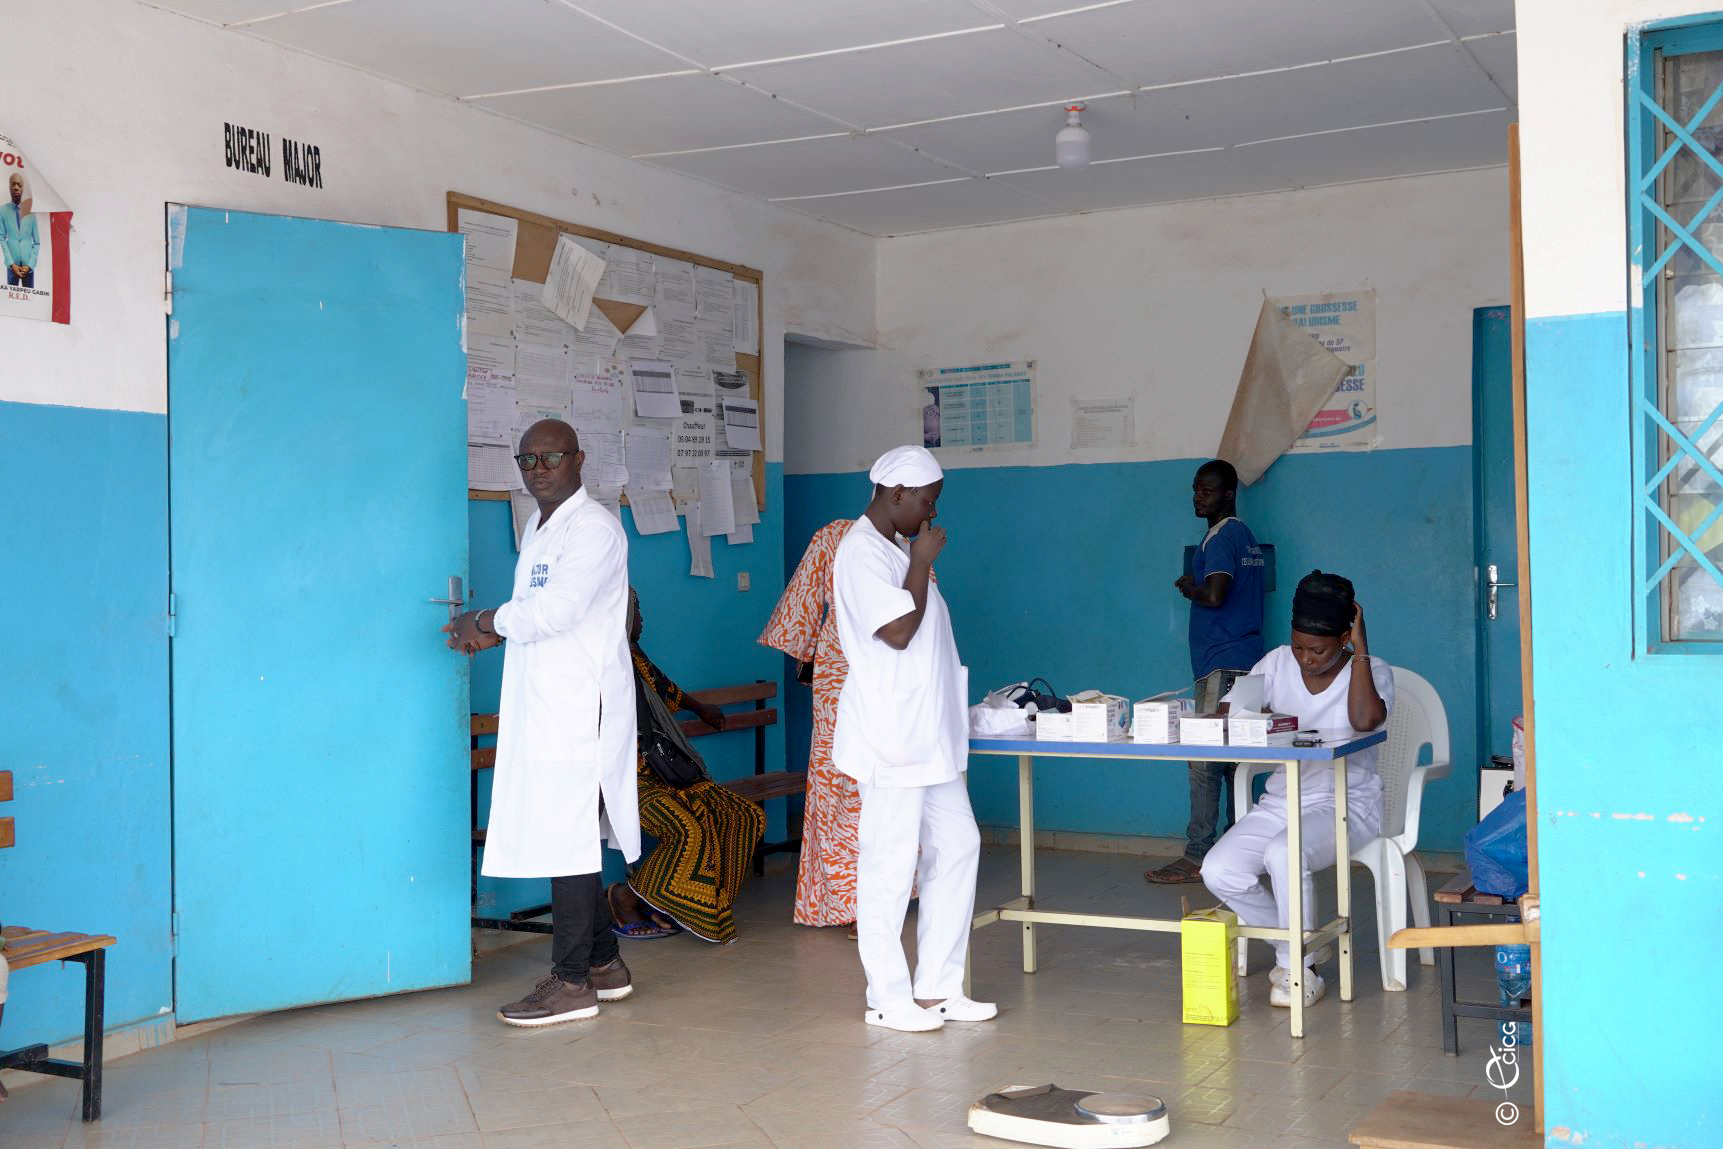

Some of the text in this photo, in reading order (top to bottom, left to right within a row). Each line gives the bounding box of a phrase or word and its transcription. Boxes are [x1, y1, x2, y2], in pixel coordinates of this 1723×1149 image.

[223, 121, 323, 189] BUREAU MAJOR
[1292, 304, 1307, 315] UNE
[1310, 301, 1359, 314] GROSSESSE
